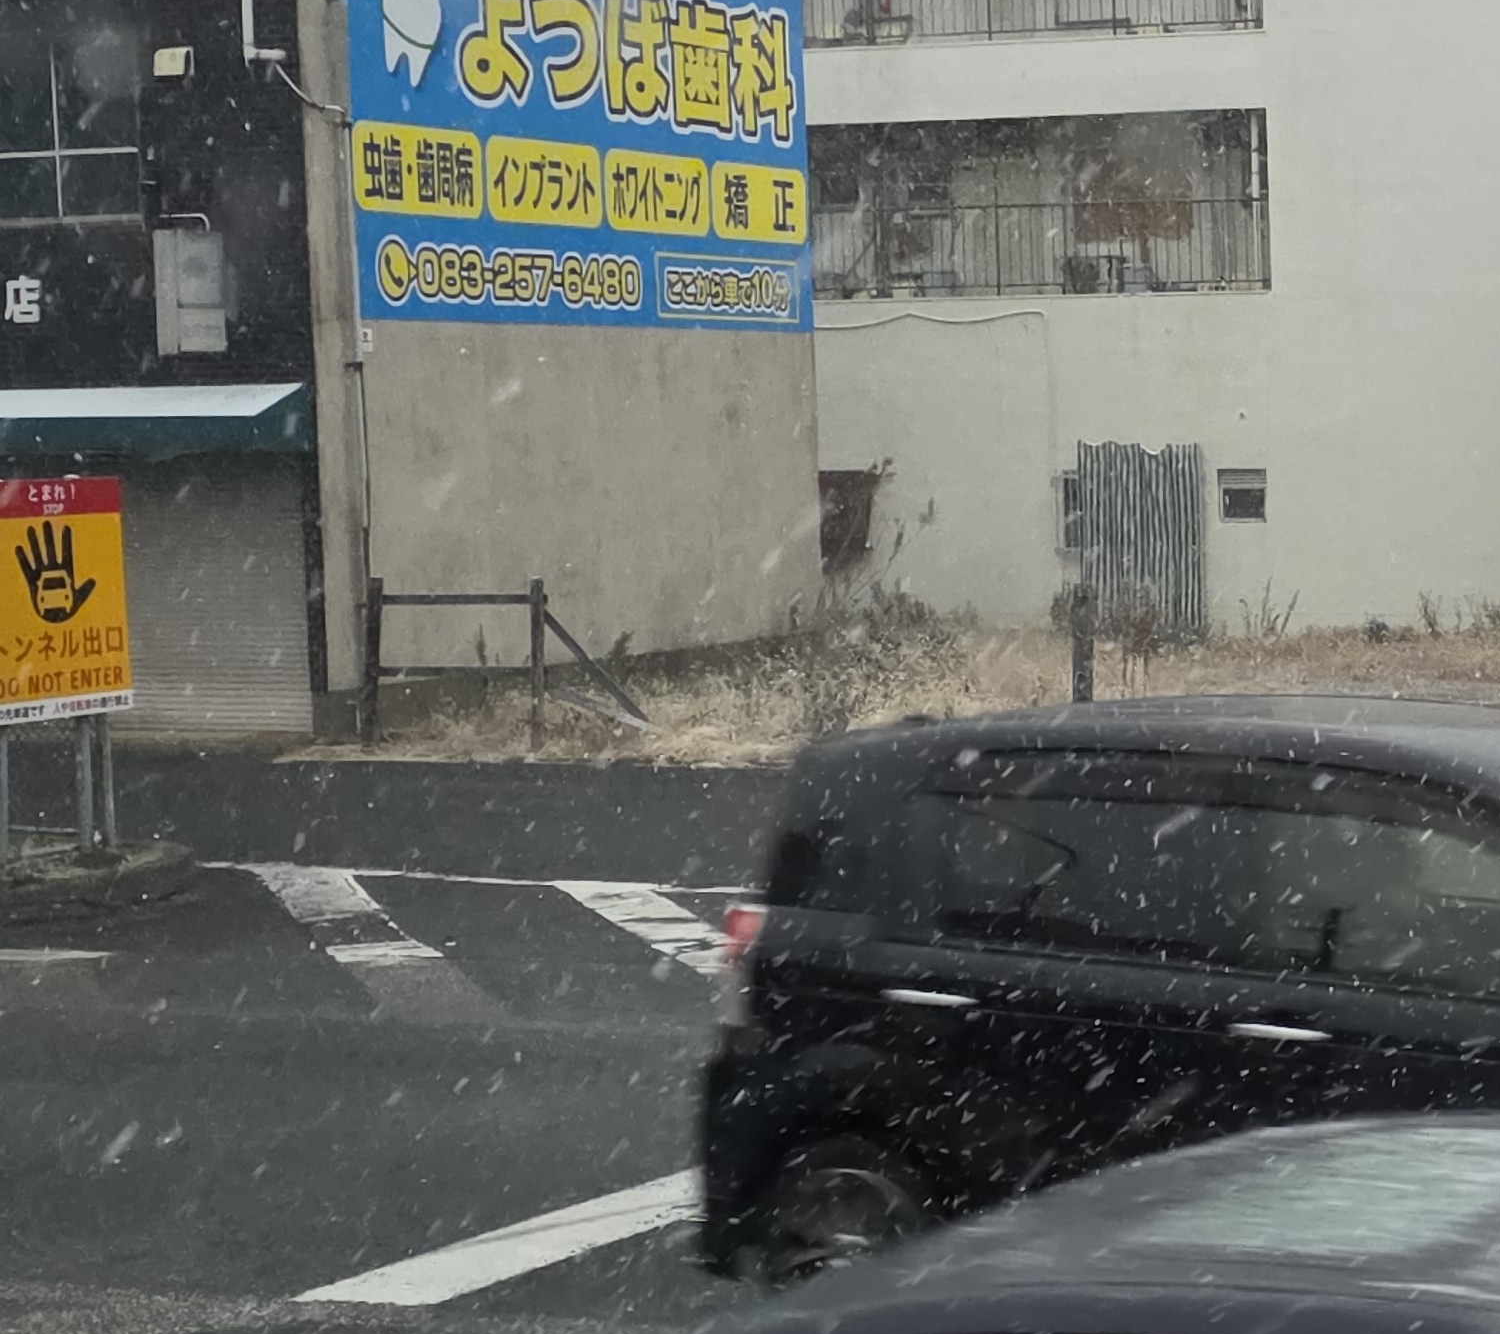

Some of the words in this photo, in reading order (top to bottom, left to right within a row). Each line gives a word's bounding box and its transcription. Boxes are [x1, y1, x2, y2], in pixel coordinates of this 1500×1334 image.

[363, 132, 475, 208] 虫歯・歯周病
[493, 154, 596, 215] インプラント
[612, 162, 702, 226] ホワイトニング
[4, 275, 42, 324] 店
[415, 244, 642, 309] 083-257-6480
[666, 267, 790, 314] ここから車で10分
[28, 671, 63, 696] NOT
[70, 666, 123, 690] ENTER
